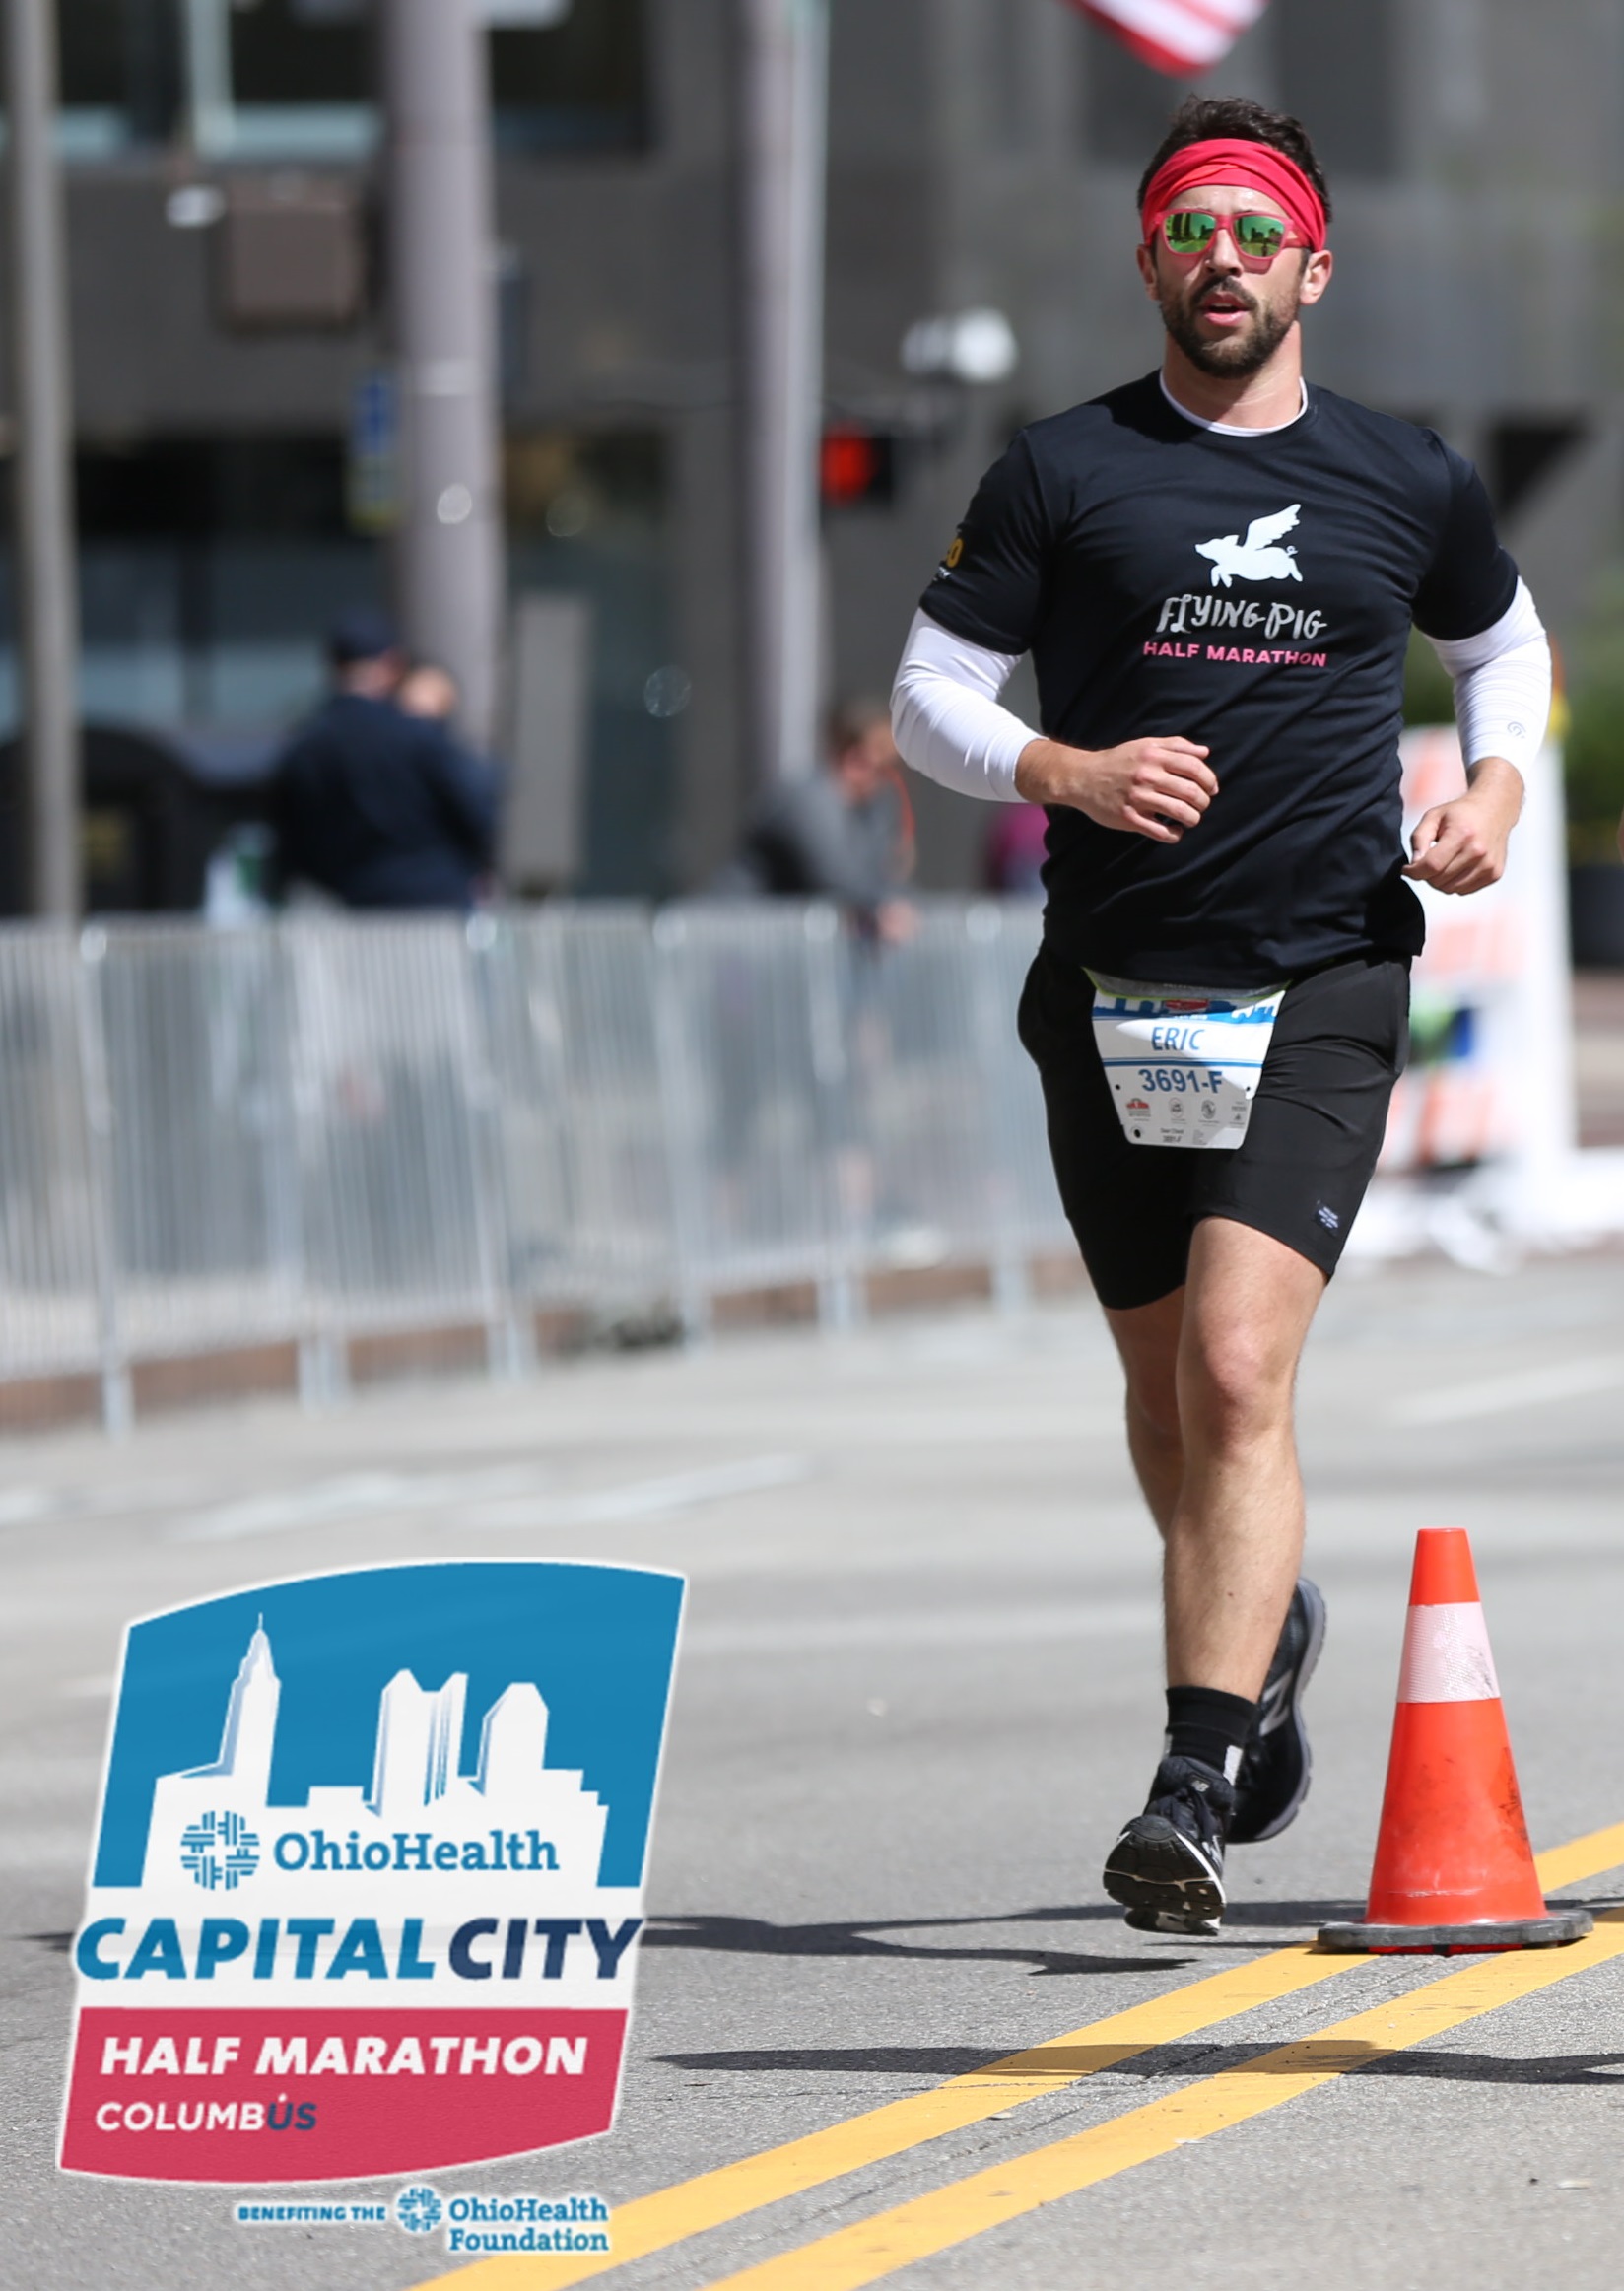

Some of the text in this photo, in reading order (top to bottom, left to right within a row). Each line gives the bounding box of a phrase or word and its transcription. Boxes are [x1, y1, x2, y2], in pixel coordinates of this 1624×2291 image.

[1156, 594, 1327, 640] FLYING PIG
[1143, 641, 1326, 667] HALF MARATHON
[1151, 1026, 1204, 1051] ERIC
[1138, 1068, 1223, 1094] 3691-F
